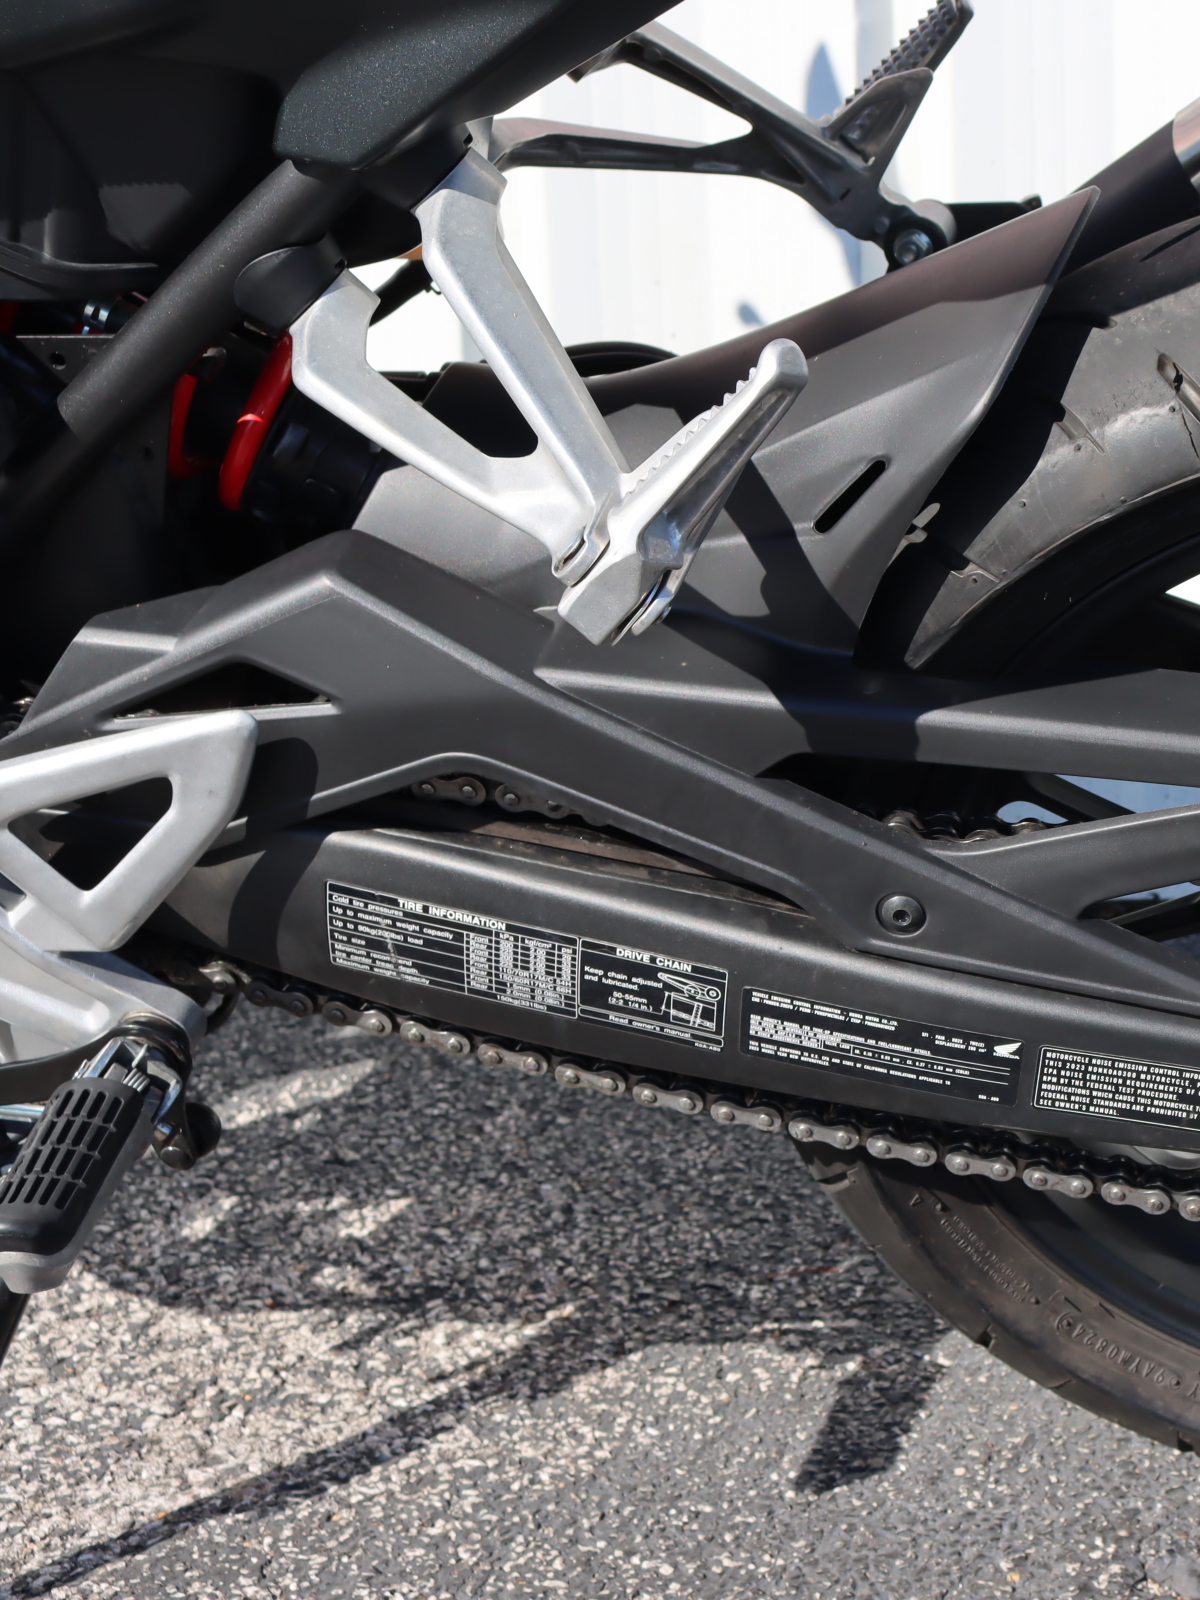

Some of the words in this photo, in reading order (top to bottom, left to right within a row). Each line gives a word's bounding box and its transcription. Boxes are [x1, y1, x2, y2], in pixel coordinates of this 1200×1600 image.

[332, 894, 349, 905] Cold
[353, 899, 364, 908] tire
[368, 903, 403, 918] pressures
[398, 899, 423, 913] TIRE
[429, 906, 506, 931] INFORMATION
[332, 906, 343, 915] Up
[346, 909, 354, 917] to
[358, 912, 392, 926] maximum
[396, 920, 419, 933] weight
[423, 926, 453, 941] capacity
[333, 919, 343, 928] Up
[347, 922, 354, 930] to
[408, 936, 423, 946] load
[334, 932, 347, 942] Tire
[351, 936, 366, 946] size
[335, 943, 366, 956] Minimum
[500, 932, 514, 942] kPa
[562, 946, 572, 956] psi
[336, 958, 370, 971] Maximum
[616, 948, 650, 963] DRIVE
[656, 957, 692, 973] CHAIN
[584, 965, 603, 977] Keep
[608, 970, 628, 981] chain
[632, 976, 663, 991] adjusted
[584, 973, 598, 982] and
[602, 977, 639, 991] lubricated.
[613, 991, 647, 1005] 50-55mm
[609, 1014, 628, 1025] Read
[632, 1019, 660, 1032] owner's
[664, 1027, 693, 1040] manual.
[1045, 1059, 1062, 1068] THIS
[1066, 1063, 1085, 1071] 2023
[1046, 1052, 1089, 1064] MOTORCYCLE
[1091, 1058, 1112, 1067] NOISE
[1114, 1062, 1148, 1072] EMISSION
[1150, 1067, 1180, 1077] CONTROL
[1043, 1075, 1057, 1083] RPM
[1086, 1082, 1116, 1092] FEDERAL
[1137, 1089, 1180, 1101] PROCEDURE.
[1044, 1067, 1057, 1075] EPA
[1060, 1070, 1083, 1079] NOISE
[1086, 1074, 1123, 1085] EMISSION
[1126, 1080, 1183, 1094] REQUIREMENTS
[1039, 1098, 1052, 1106] SEE
[1055, 1101, 1086, 1111] OWNER'S
[1089, 1106, 1120, 1116] MANUAL.
[1041, 1091, 1068, 1101] FEDERAL
[1071, 1095, 1090, 1104] NOISE
[1093, 1099, 1130, 1110] STANDARDS
[1132, 1104, 1144, 1112] ARE
[1147, 1107, 1187, 1118] PROHIBITED
[1042, 1083, 1090, 1096] MODIFICATIONS
[1092, 1091, 1113, 1099] WHICH
[1115, 1094, 1135, 1103] CAUSE
[1137, 1097, 1151, 1105] THIS
[1153, 1099, 1194, 1111] MOTORCYCLE
